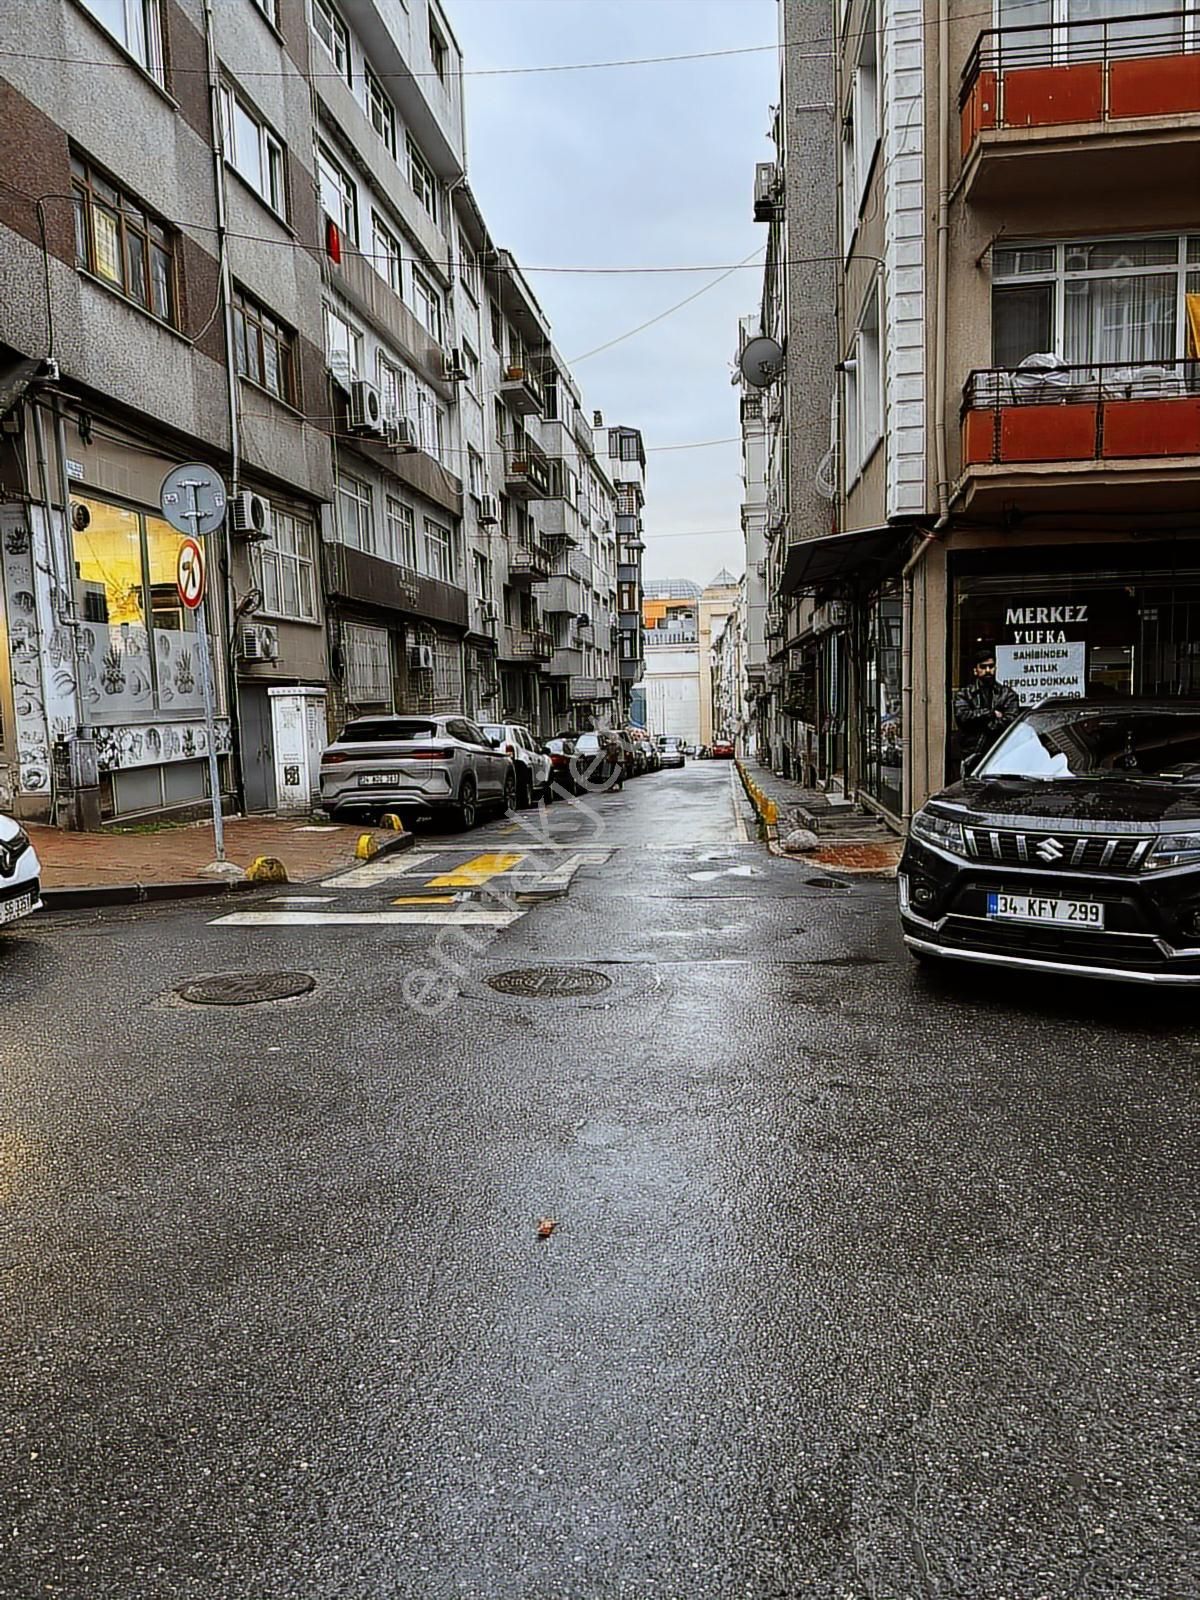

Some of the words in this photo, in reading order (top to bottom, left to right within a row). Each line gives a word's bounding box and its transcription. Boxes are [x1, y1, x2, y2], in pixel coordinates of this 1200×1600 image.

[1005, 605, 1089, 625] MERKEZ
[1014, 630, 1067, 644] YUFKA
[1023, 663, 1058, 673] SATILIK
[999, 896, 1018, 915] 34
[1028, 898, 1059, 919] KFY
[1067, 903, 1100, 922] 299
